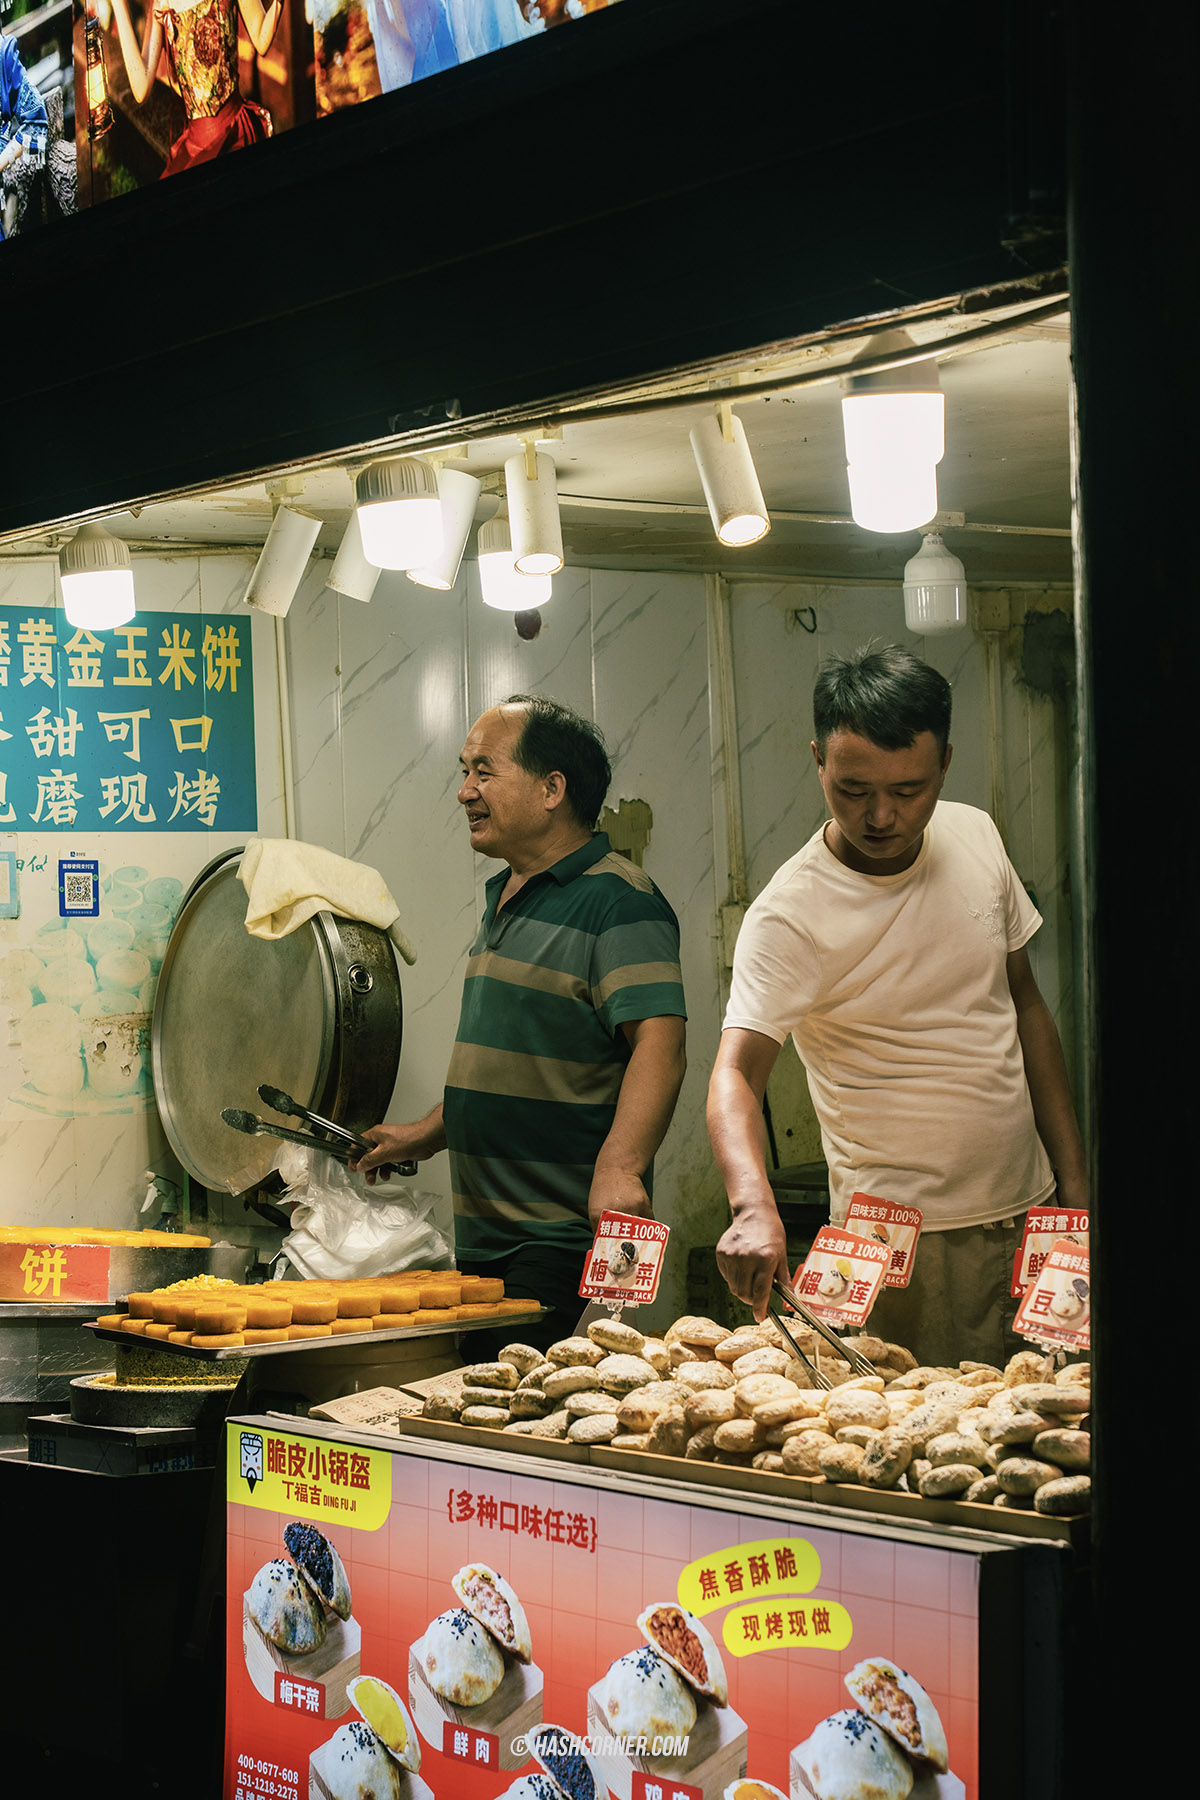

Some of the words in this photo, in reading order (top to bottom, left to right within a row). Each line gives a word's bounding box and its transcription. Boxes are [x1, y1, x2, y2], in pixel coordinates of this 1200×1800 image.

[0, 618, 241, 692] 黄金玉米饼
[0, 706, 214, 762] 甜可口
[0, 769, 221, 826] 磨现烤
[850, 1203, 888, 1220] 回味无穷
[888, 1209, 920, 1225] 100%
[1028, 1215, 1069, 1232] 不踩雷
[600, 1220, 632, 1237] 销量王
[632, 1224, 667, 1240] 100%
[815, 1236, 855, 1254] 女生超爱
[855, 1243, 889, 1261] 100%
[890, 1250, 907, 1272] 黄
[20, 1248, 68, 1297] 饼
[589, 1258, 609, 1282] 梅
[635, 1262, 655, 1287] 菜
[846, 1279, 872, 1306] 莲
[1030, 1289, 1056, 1317] 豆
[267, 1438, 370, 1490] 脆皮小锅盔
[282, 1480, 322, 1506] 丁福吉
[323, 1494, 339, 1509] DING
[340, 1498, 349, 1511] FU
[350, 1500, 357, 1512] JI
[698, 1546, 798, 1600] 焦香酥脆
[741, 1607, 831, 1642] 现烤现做
[279, 1678, 320, 1713] 梅干菜
[453, 1730, 490, 1763] 鲜肉
[237, 1753, 299, 1784] 400-0677-608
[237, 1771, 298, 1800] 151-1218-2273
